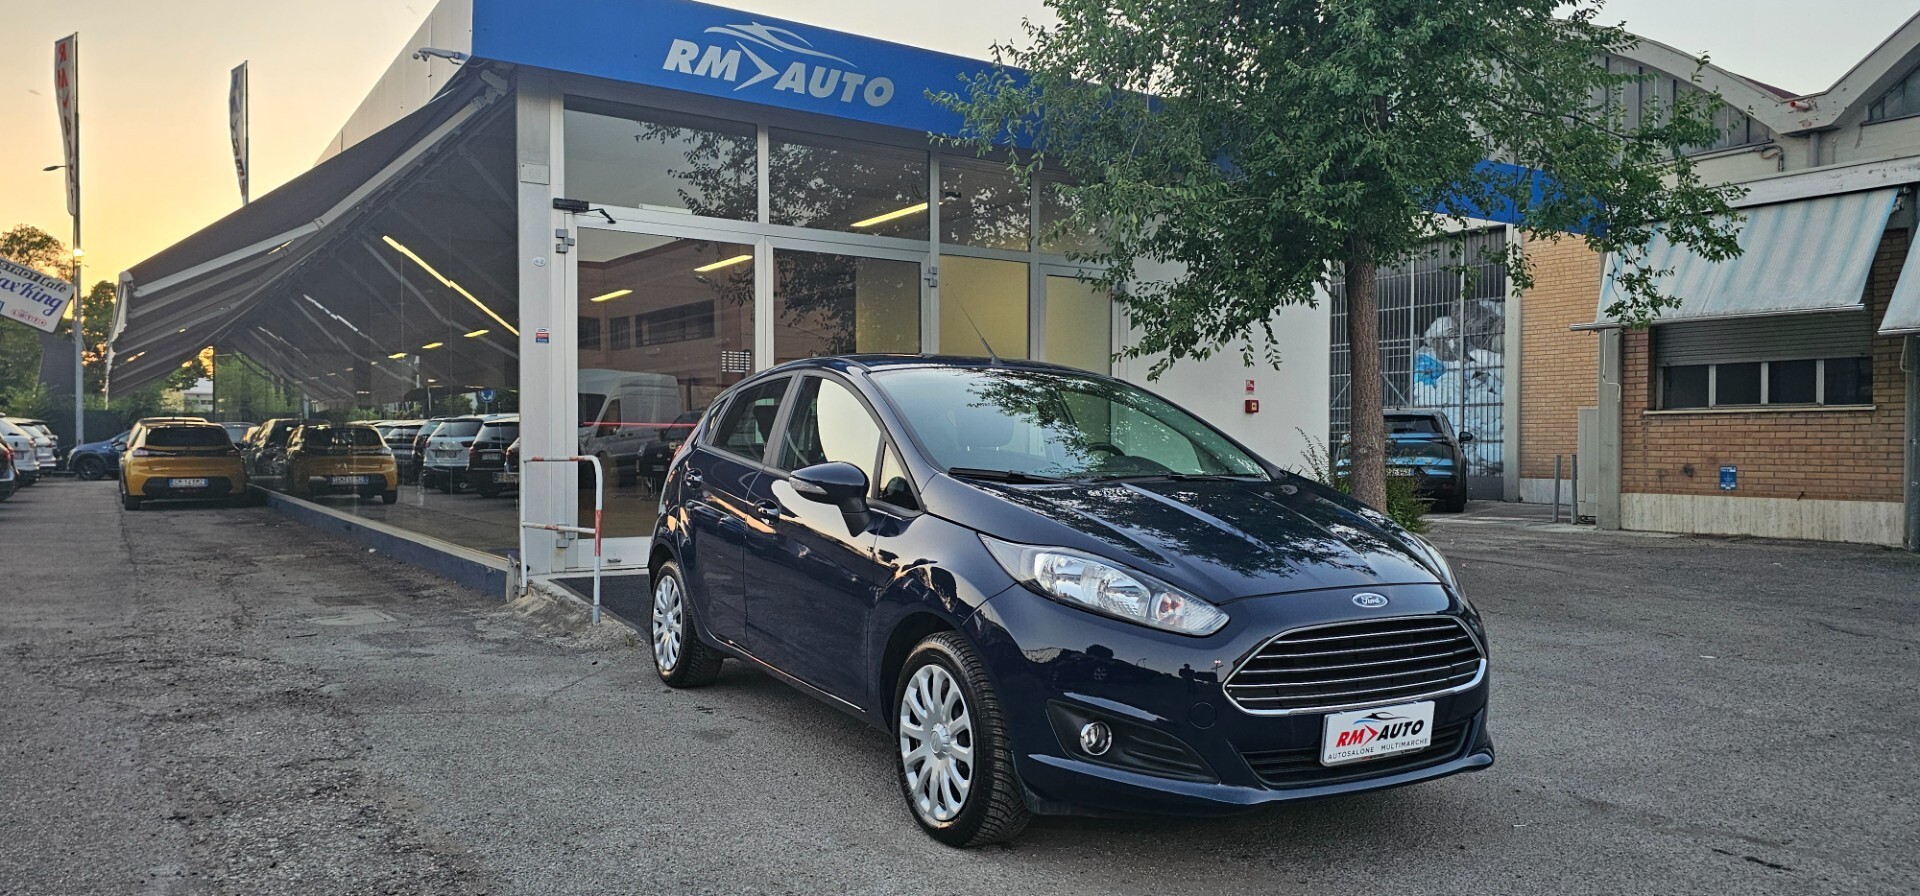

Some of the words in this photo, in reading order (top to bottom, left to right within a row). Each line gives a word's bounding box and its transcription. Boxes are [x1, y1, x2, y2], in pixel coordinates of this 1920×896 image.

[662, 38, 742, 82] RM
[773, 61, 895, 107] AUTO
[0, 278, 63, 316] axKing
[1357, 594, 1384, 606] Ford
[1336, 728, 1366, 748] RM
[1376, 719, 1425, 741] AUTO
[1327, 746, 1375, 760] AUTOSALONE
[1381, 737, 1428, 751] MULTIMARCHE
